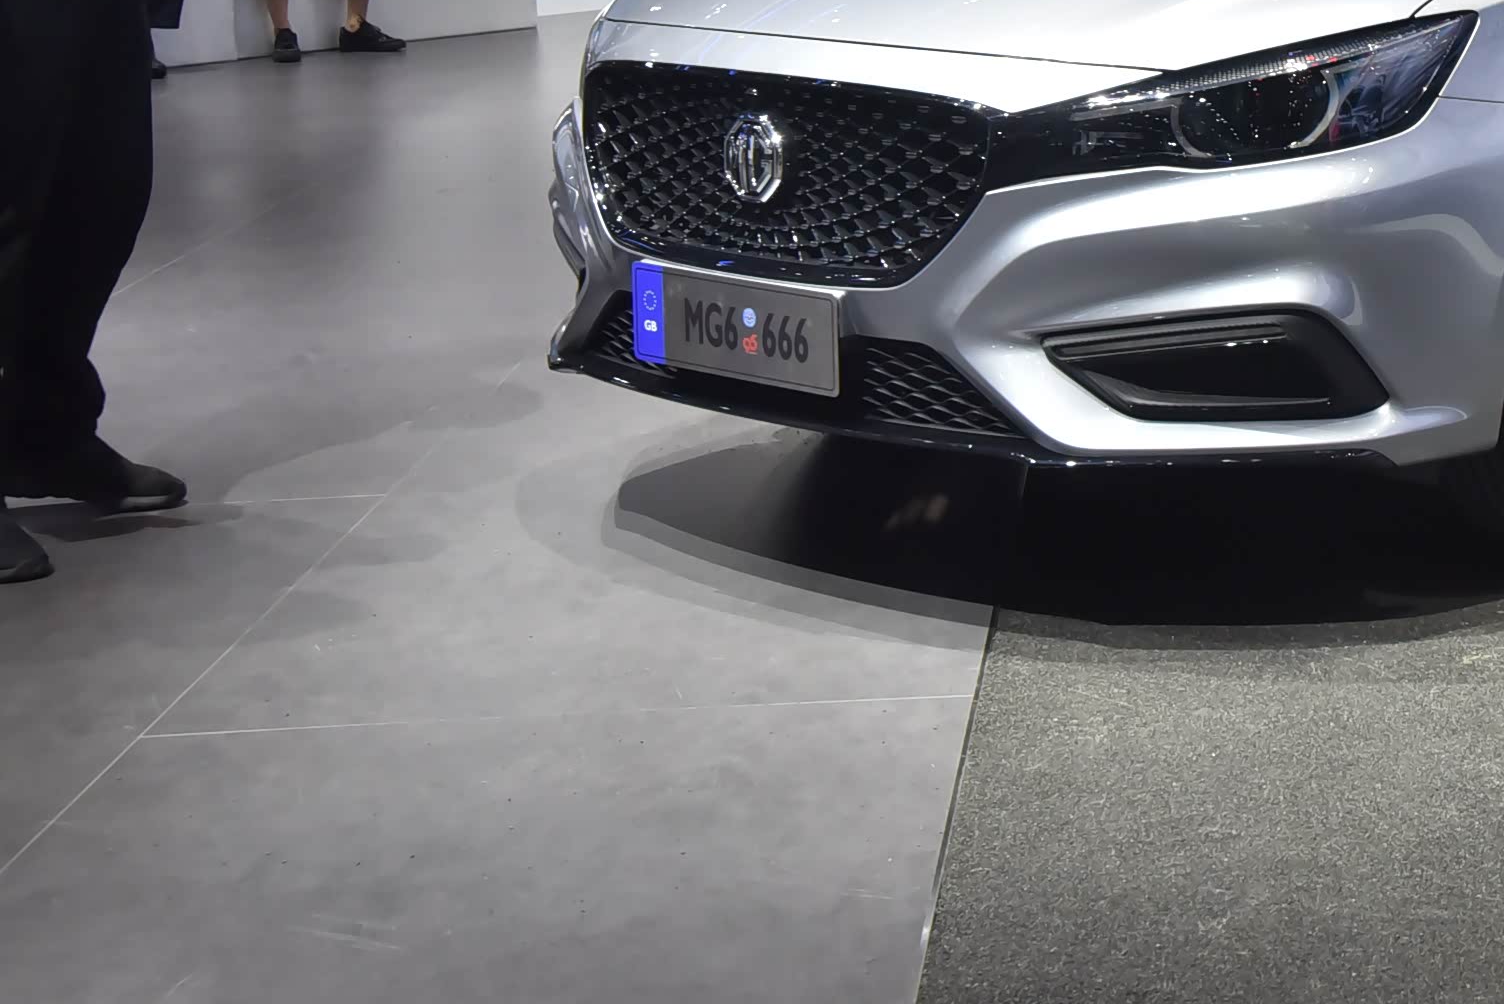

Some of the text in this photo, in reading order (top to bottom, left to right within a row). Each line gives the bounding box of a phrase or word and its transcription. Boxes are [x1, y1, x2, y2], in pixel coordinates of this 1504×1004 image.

[643, 319, 658, 333] GB
[684, 297, 809, 363] MG6 666
